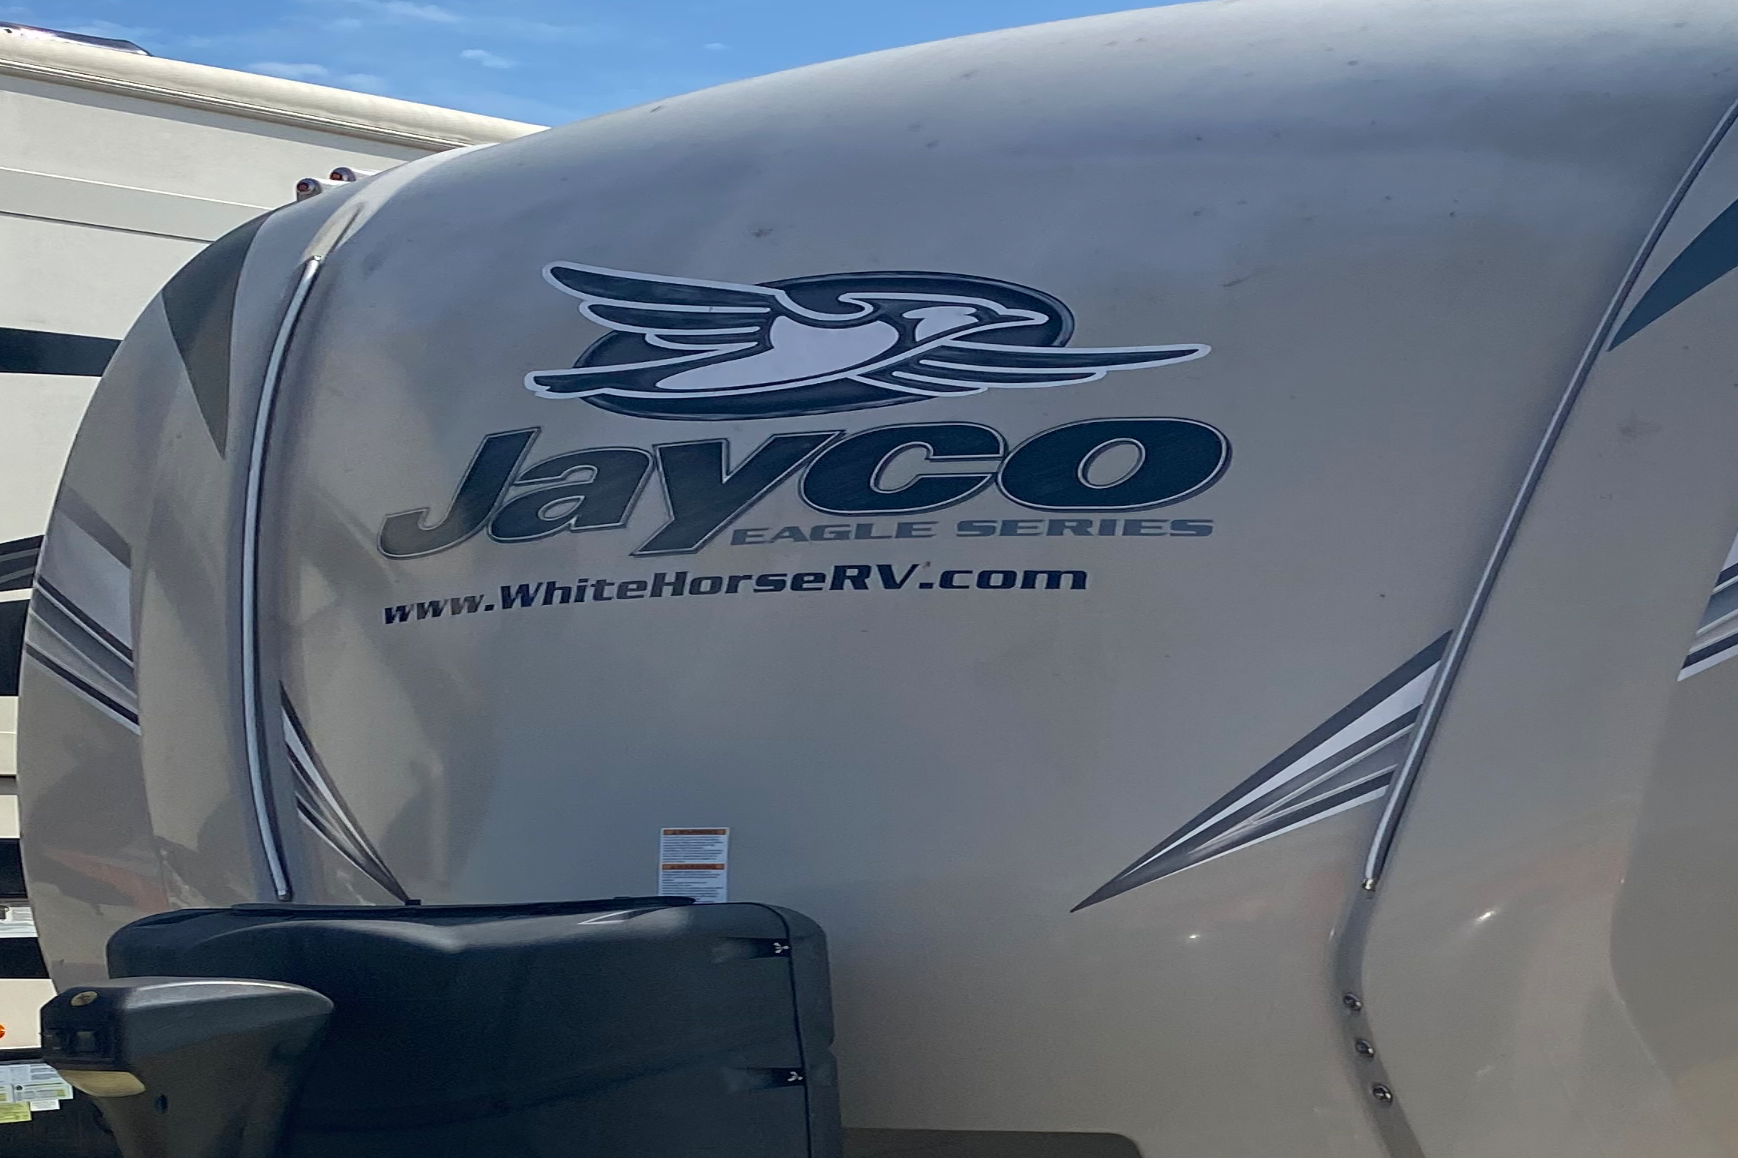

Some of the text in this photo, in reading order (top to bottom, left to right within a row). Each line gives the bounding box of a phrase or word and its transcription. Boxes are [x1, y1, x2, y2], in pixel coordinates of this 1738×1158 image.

[377, 417, 1233, 559] Jayco
[729, 518, 1214, 545] EAGLE SERIES
[384, 562, 1088, 625] www.WhiteHorseRV.com
